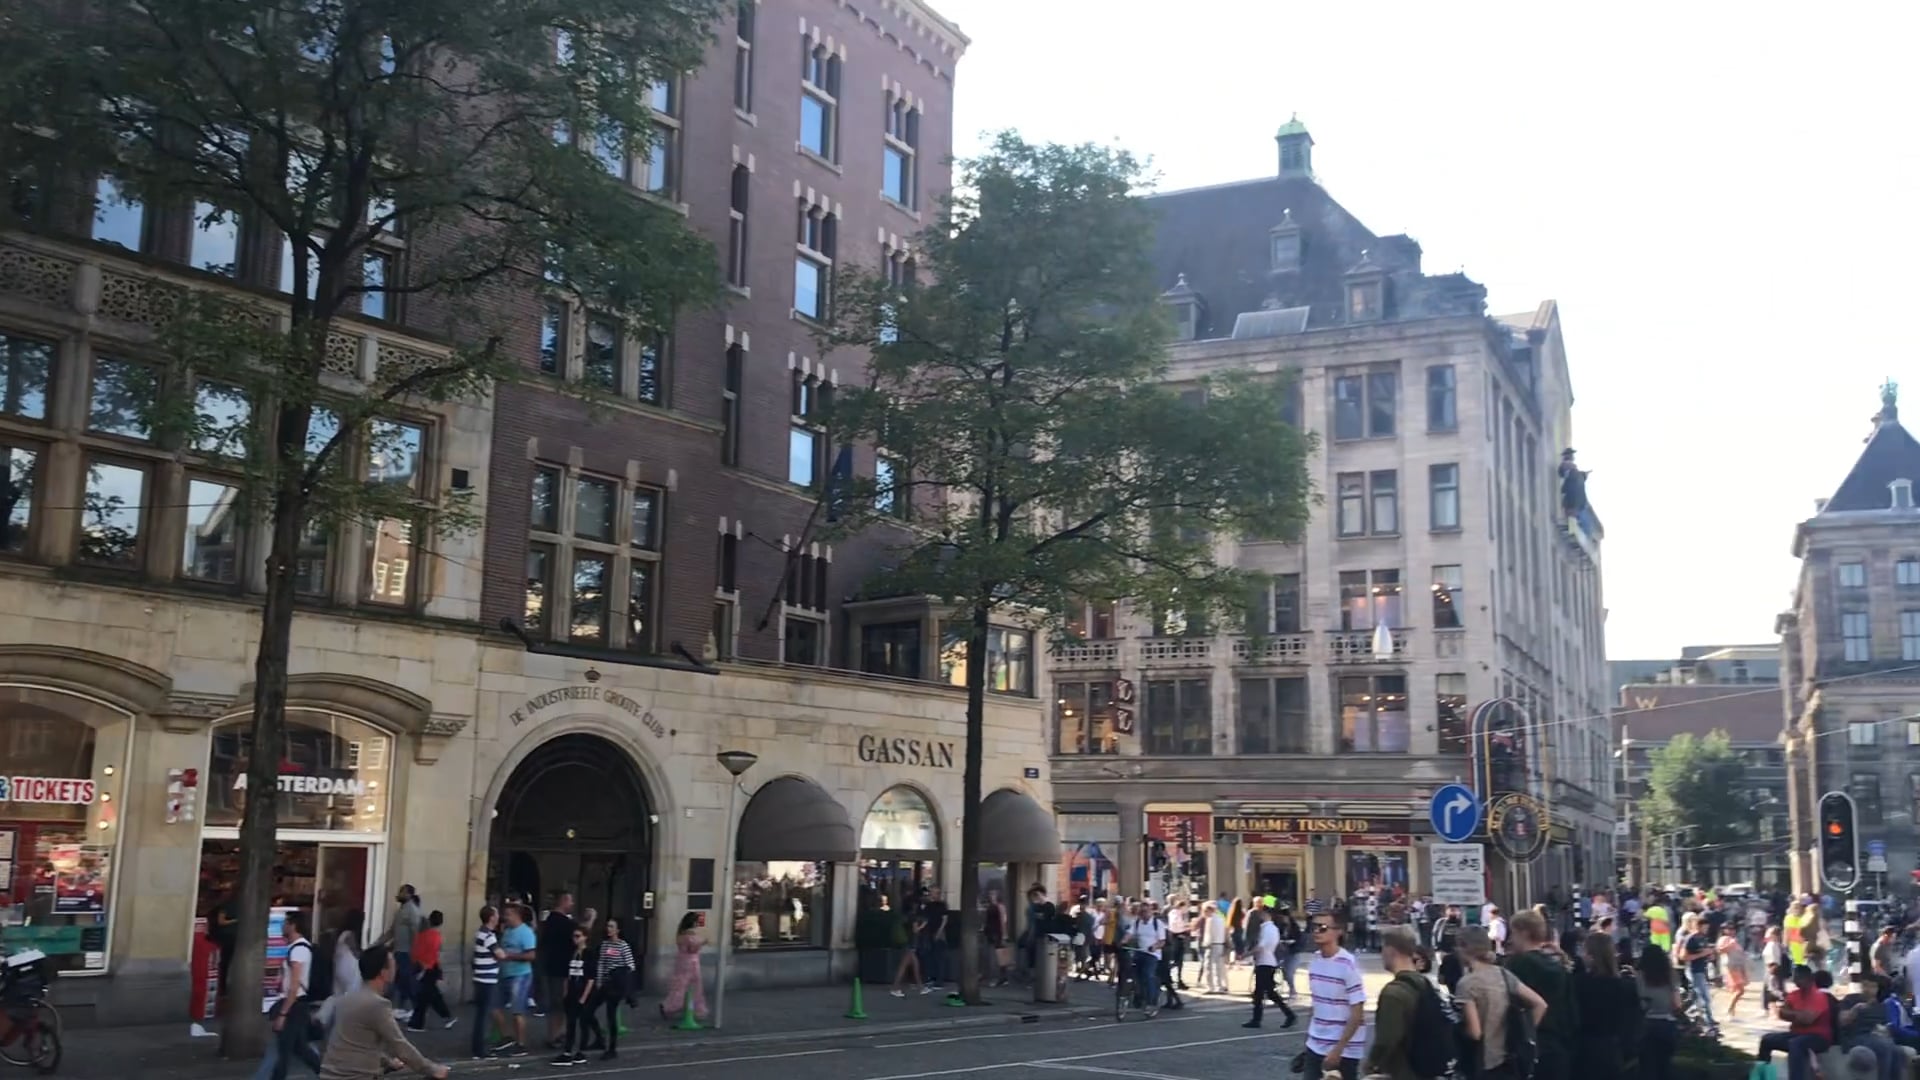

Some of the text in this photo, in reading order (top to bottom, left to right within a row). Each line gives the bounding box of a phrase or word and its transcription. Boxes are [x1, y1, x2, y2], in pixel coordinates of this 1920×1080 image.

[509, 707, 525, 727] DE
[604, 689, 643, 716] GROOTE
[858, 734, 955, 768] GASSAN
[12, 778, 96, 803] TICKETS
[232, 772, 365, 795] ATERDAM
[1223, 818, 1292, 832] MADAME
